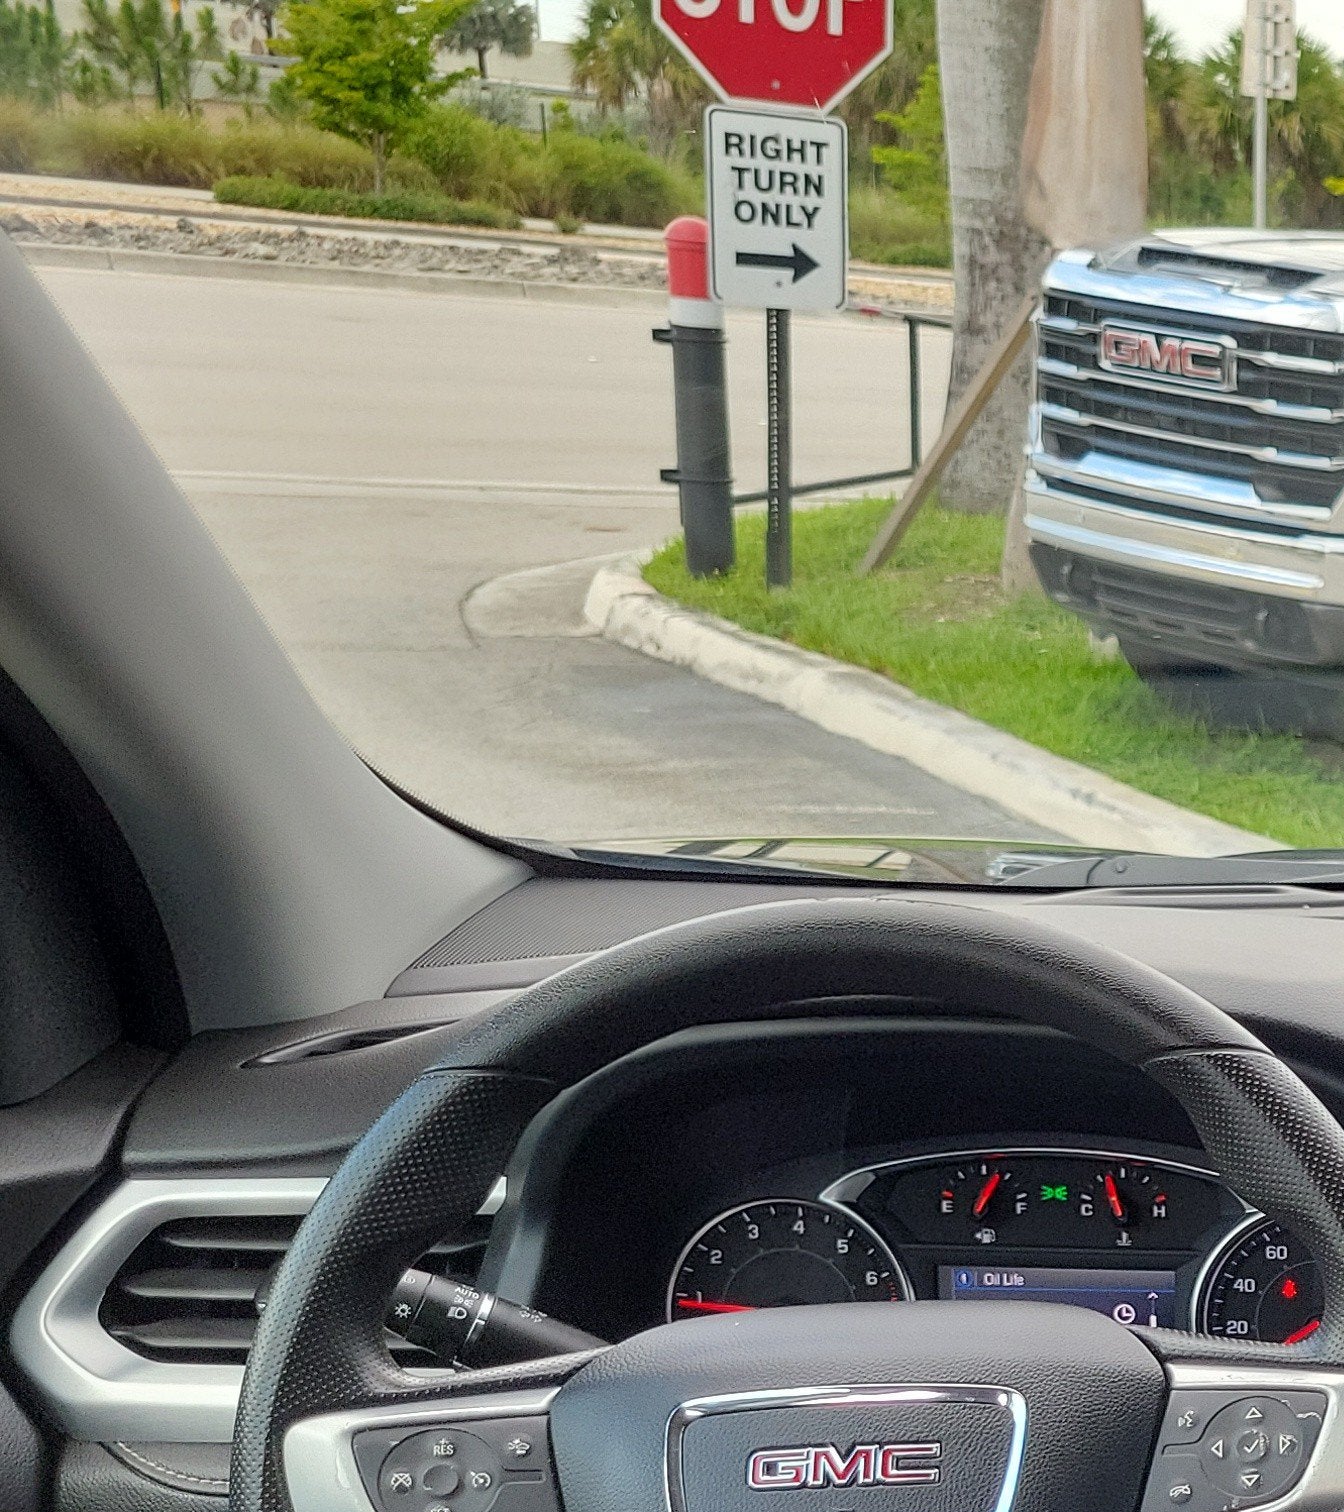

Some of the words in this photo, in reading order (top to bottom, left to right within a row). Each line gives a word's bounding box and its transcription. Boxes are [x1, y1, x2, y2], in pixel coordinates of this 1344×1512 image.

[724, 131, 830, 166] RIGHT
[731, 166, 825, 197] TURN
[734, 200, 821, 229] ONLY
[1104, 329, 1222, 382] GMC
[941, 1200, 953, 1213] E
[1016, 1202, 1027, 1215] F
[1081, 1203, 1093, 1217] C
[1152, 1204, 1166, 1218] H
[748, 1224, 759, 1239] 3
[793, 1220, 805, 1234] 4
[837, 1239, 849, 1254] 5
[1265, 1245, 1288, 1260] 60
[709, 1249, 723, 1265] 2
[865, 1271, 878, 1286] 6
[982, 1273, 1001, 1286] Oil
[1003, 1273, 1025, 1287] Life
[1233, 1278, 1256, 1293] 40
[454, 1286, 480, 1300] AUTO
[1225, 1320, 1248, 1334] 20
[433, 1444, 454, 1456] RES
[748, 1442, 942, 1490] GMC
